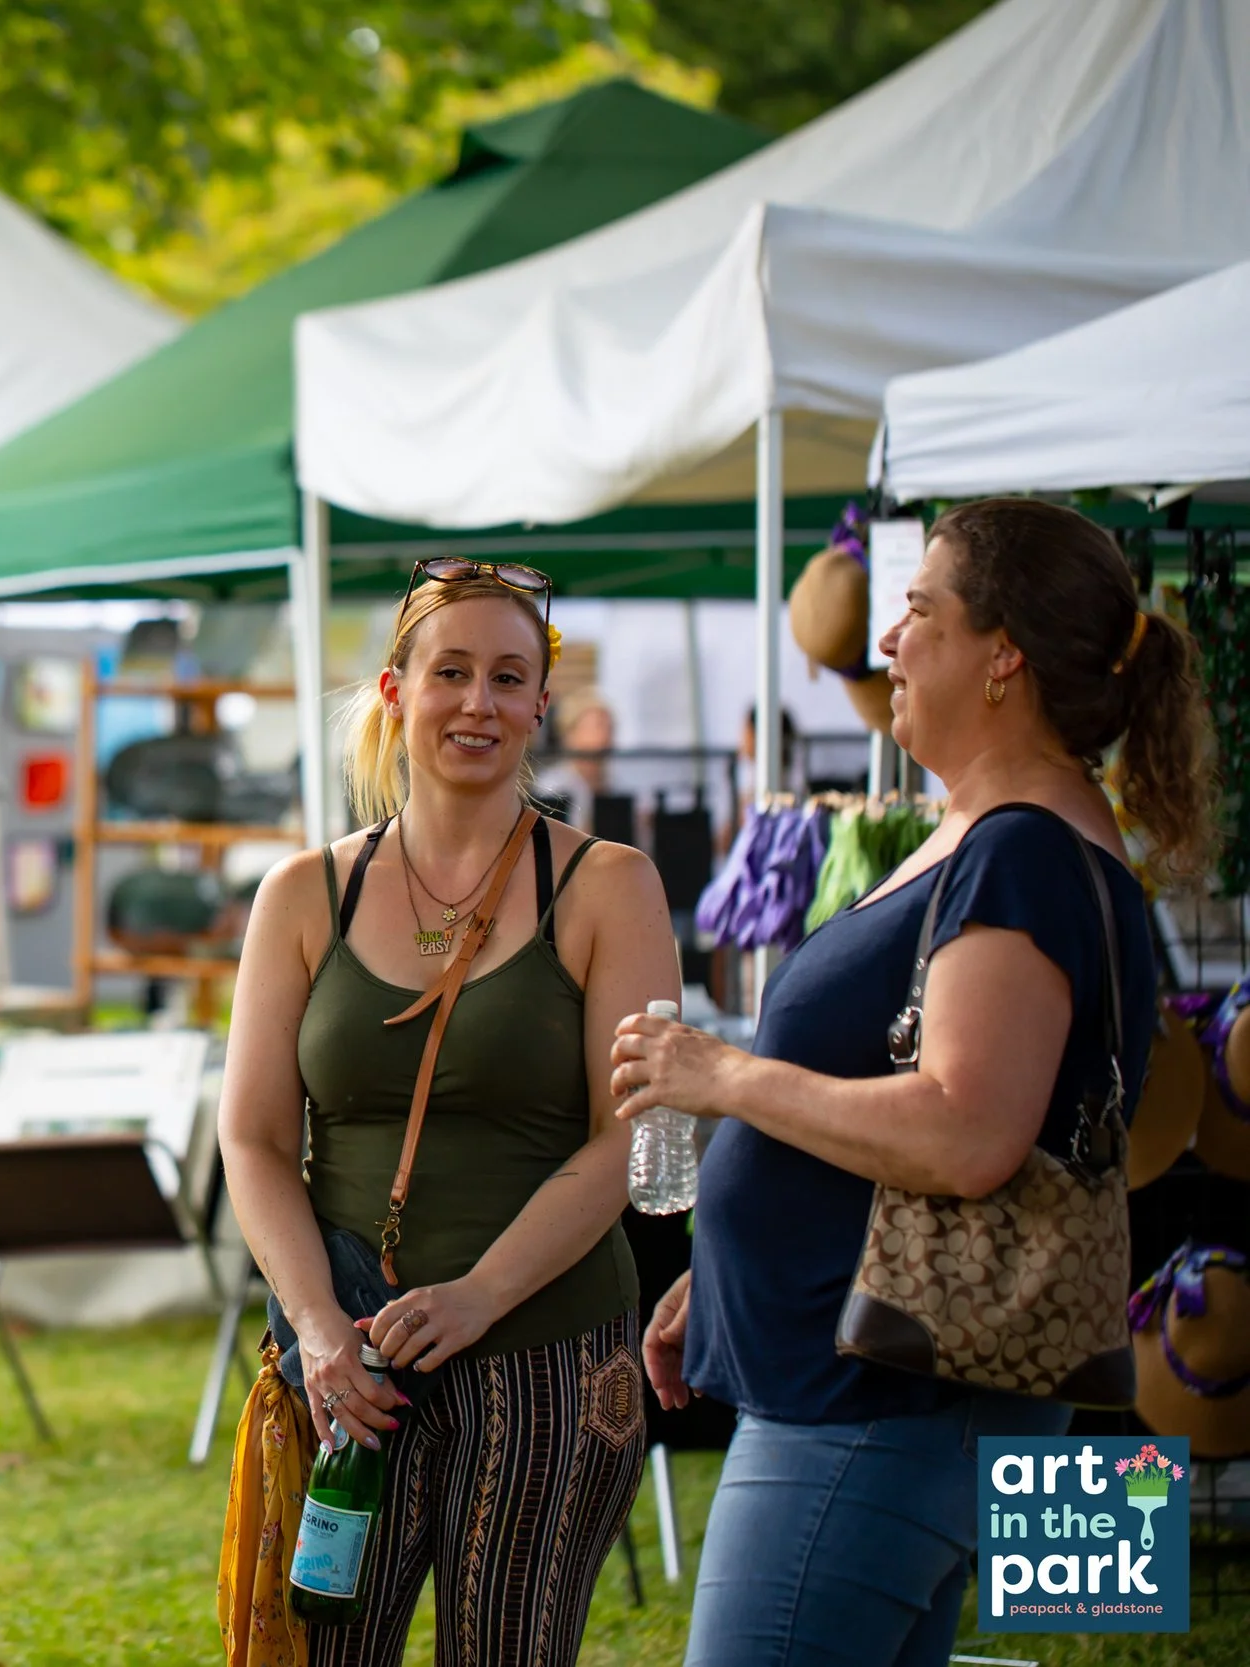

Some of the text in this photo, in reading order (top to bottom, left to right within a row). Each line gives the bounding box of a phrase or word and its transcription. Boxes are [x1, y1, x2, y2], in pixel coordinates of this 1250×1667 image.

[413, 929, 454, 944] TAKE IT
[420, 940, 451, 955] EASY
